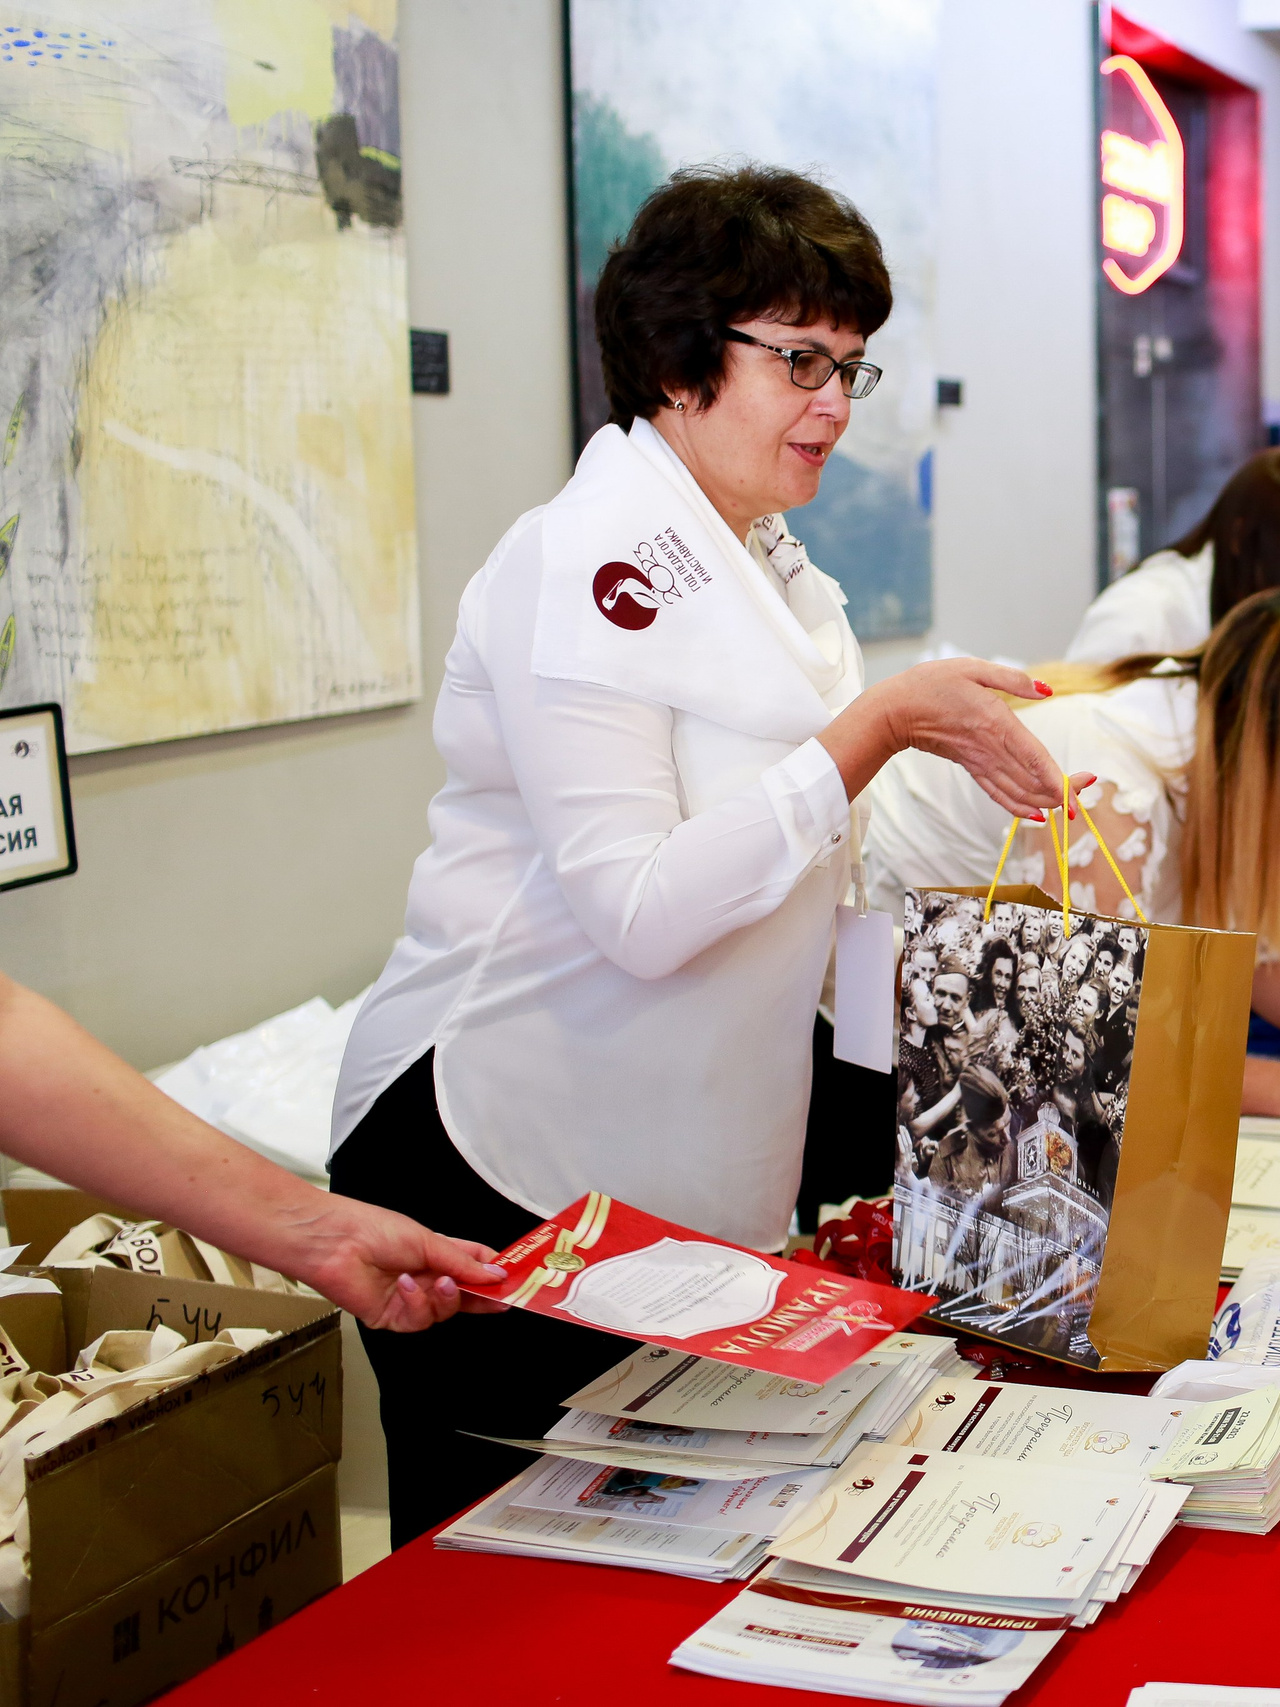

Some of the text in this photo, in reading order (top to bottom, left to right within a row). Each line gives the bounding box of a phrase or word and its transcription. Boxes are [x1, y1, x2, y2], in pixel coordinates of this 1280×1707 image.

[654, 533, 701, 593] ГОД ПЕДАГОГА
[664, 526, 709, 579] НАСТАВНИКА
[1077, 1178, 1100, 1199] ОКЗАЛ
[710, 1277, 853, 1355] ГРАМОТА
[224, 1350, 275, 1383] КОНФИЛ
[709, 1368, 755, 1406] рограмма
[128, 1398, 182, 1430] КОНФИЛ
[1014, 1404, 1073, 1461] Программ
[935, 1491, 1000, 1559] Программа
[157, 1509, 317, 1635] КОНФИЛ
[901, 1604, 1040, 1631] ПРИГЛАШЕНИЕ
